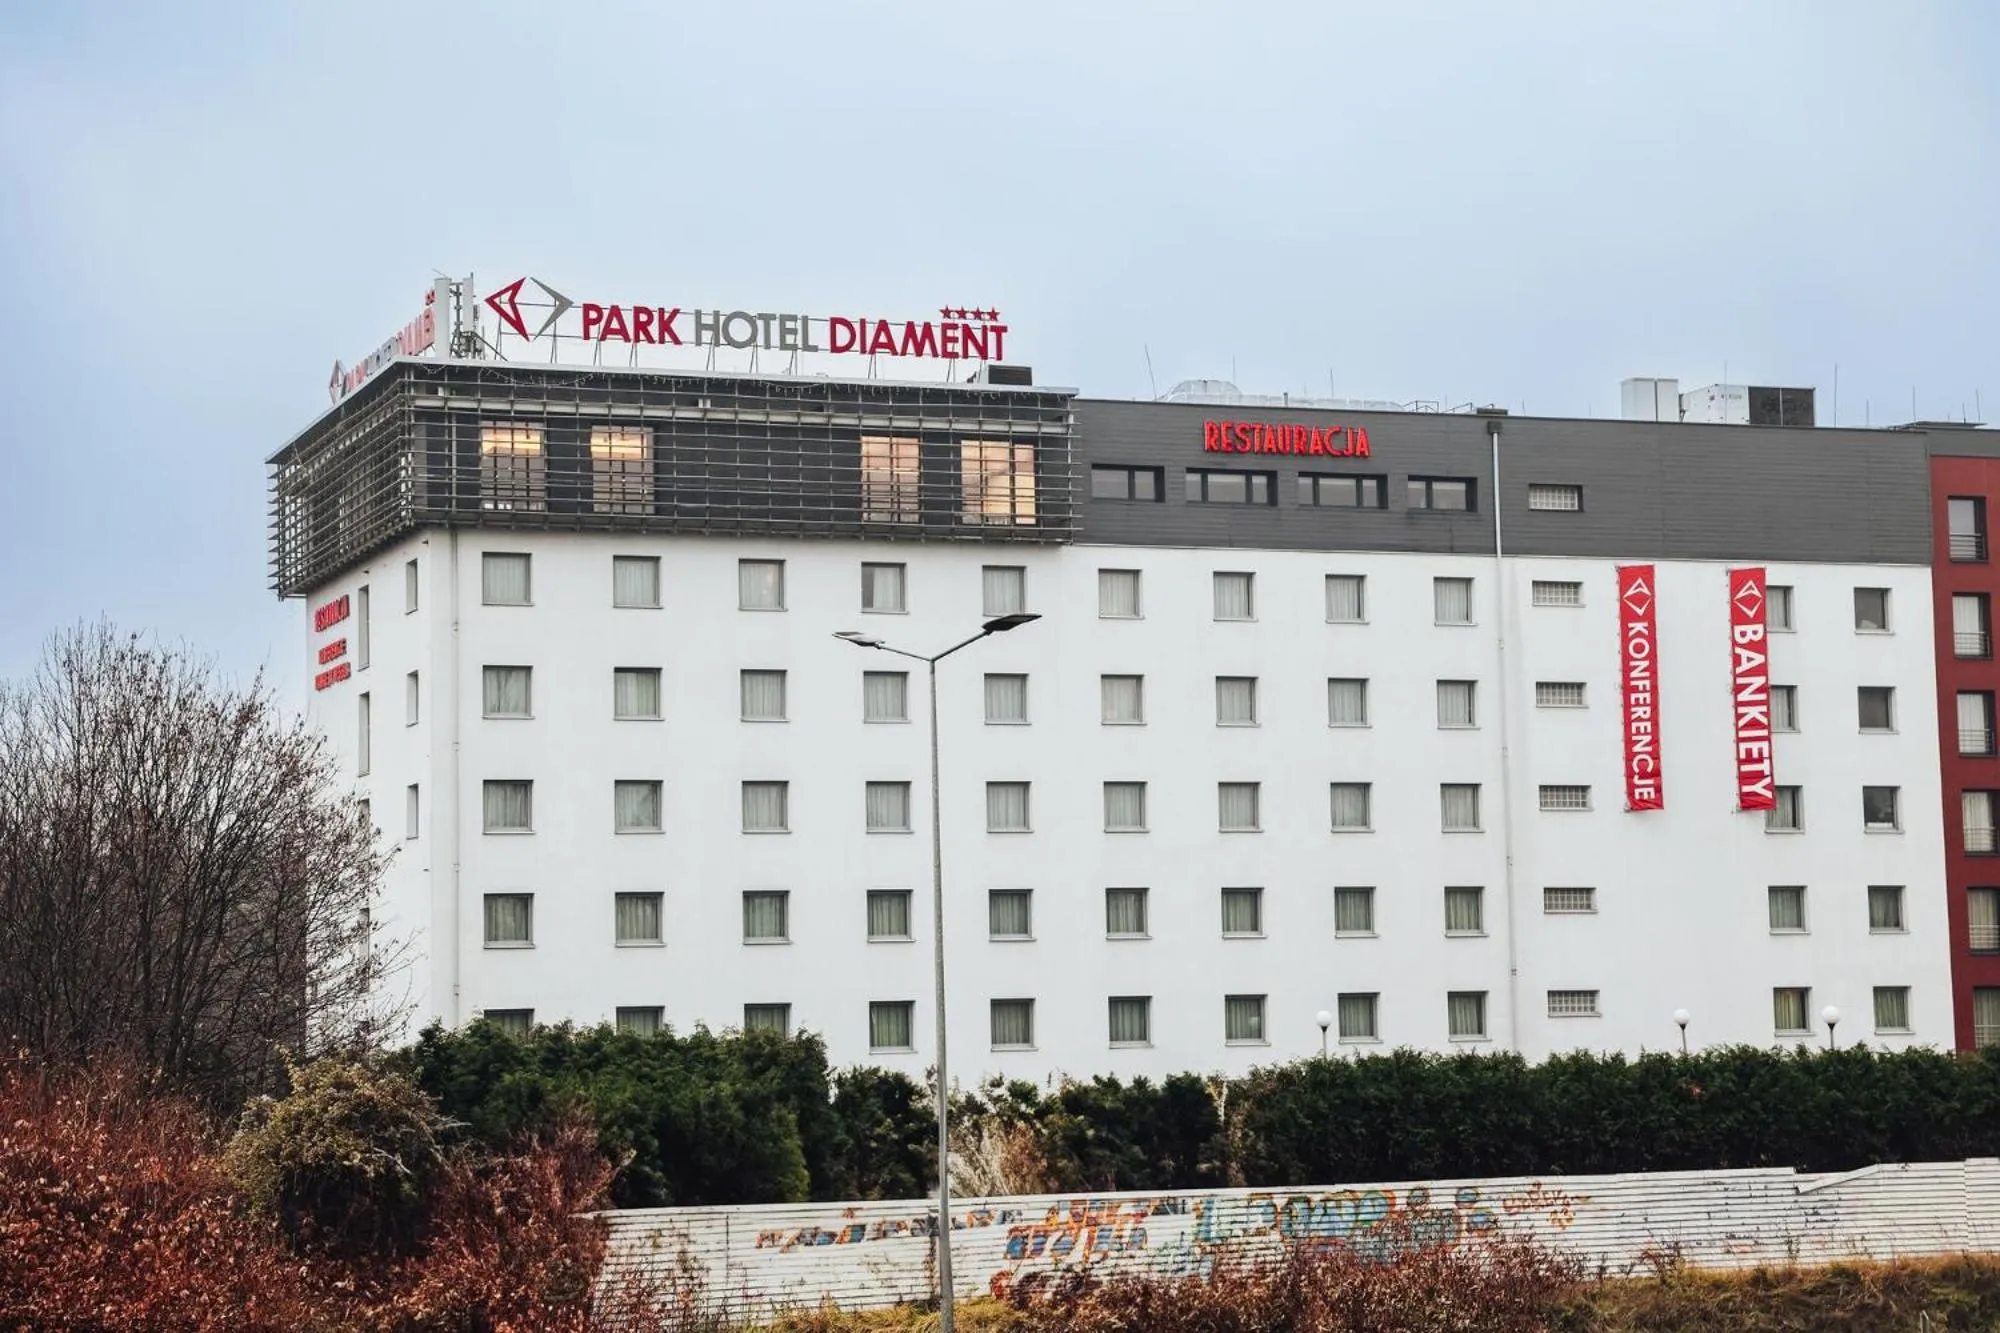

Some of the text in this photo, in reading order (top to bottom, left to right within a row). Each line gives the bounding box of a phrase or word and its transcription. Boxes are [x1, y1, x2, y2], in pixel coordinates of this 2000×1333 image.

[582, 303, 1008, 361] PARK HOTEL DIAMENT
[1204, 420, 1371, 458] RESTAURACJA
[1627, 621, 1656, 801] KONFERENCJE
[1733, 623, 1773, 799] BANKIETY
